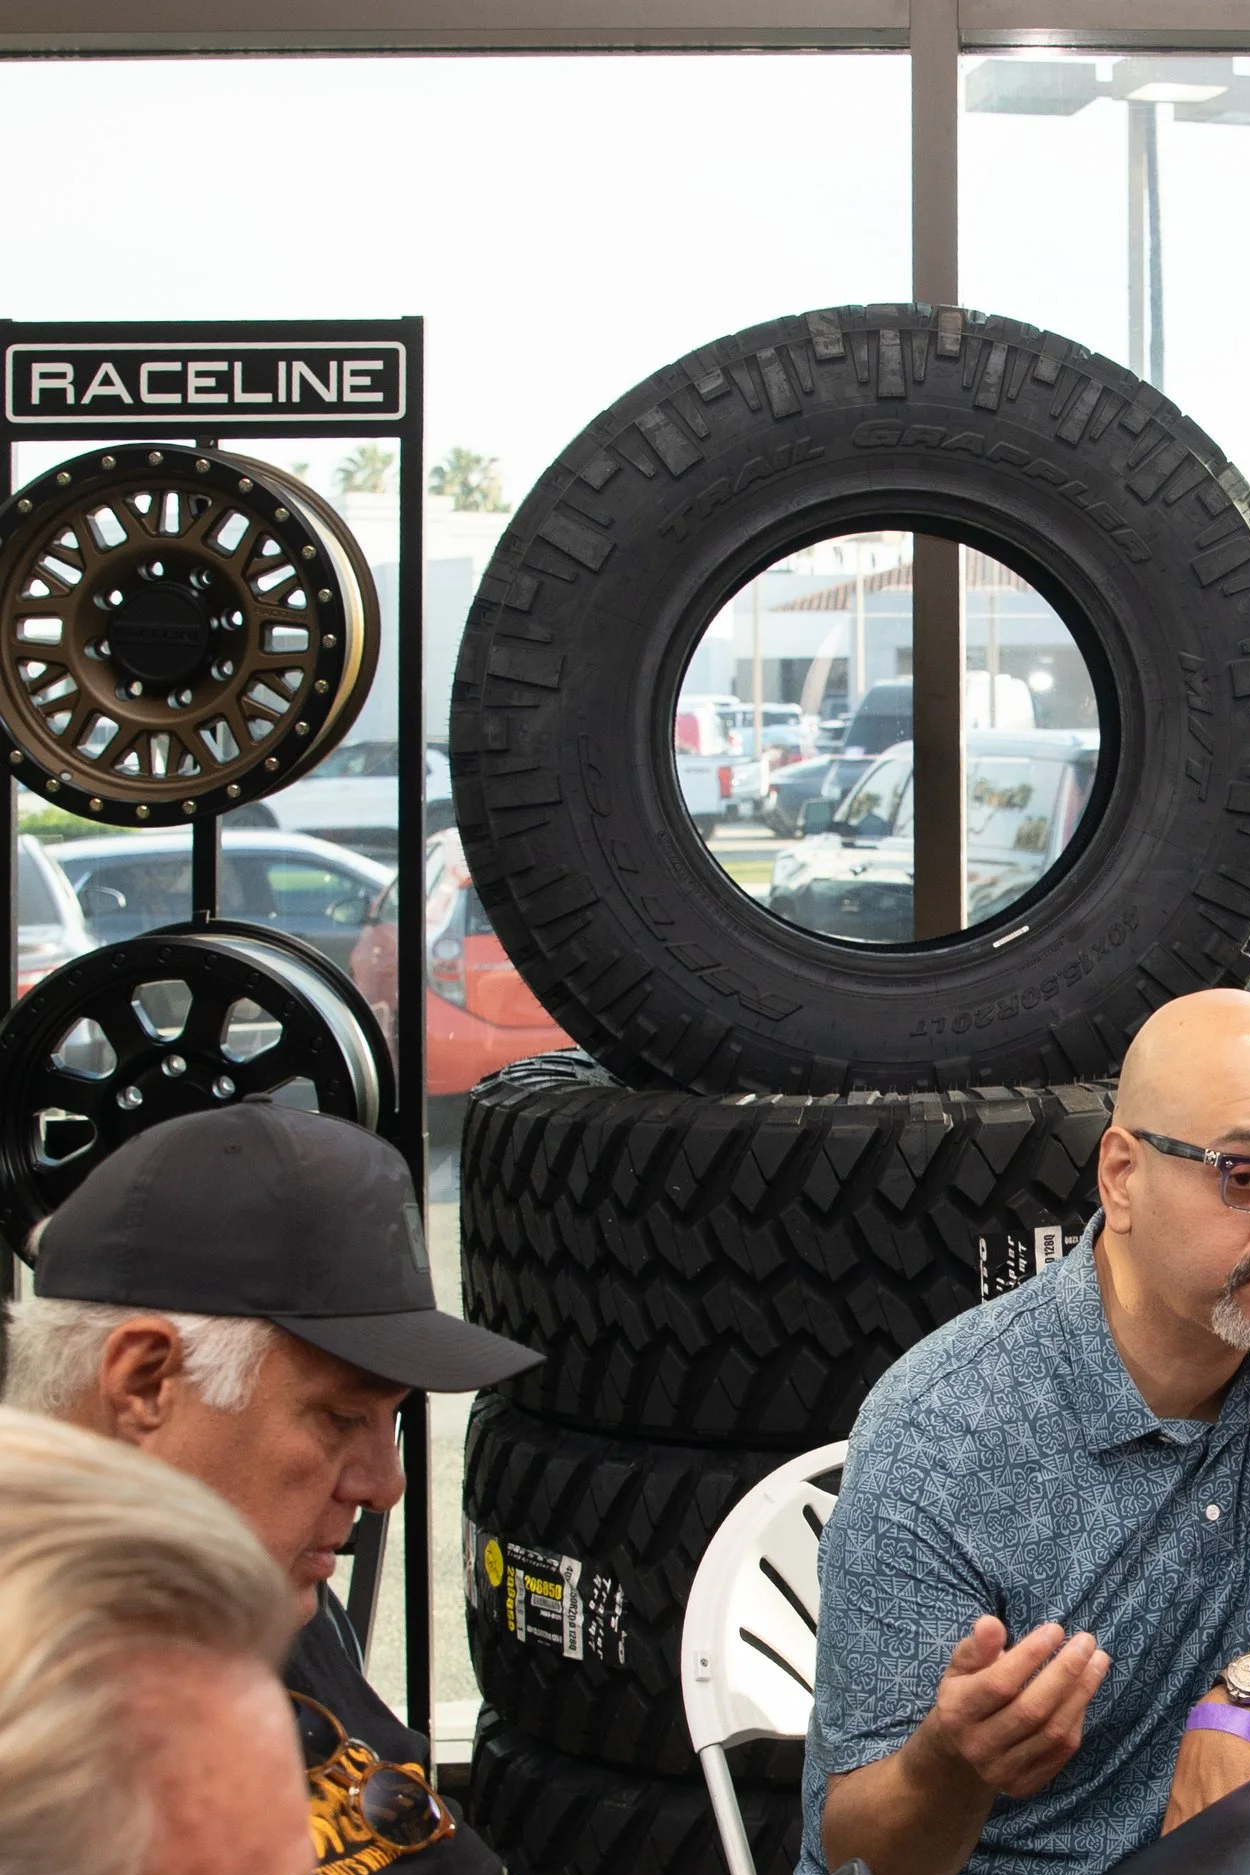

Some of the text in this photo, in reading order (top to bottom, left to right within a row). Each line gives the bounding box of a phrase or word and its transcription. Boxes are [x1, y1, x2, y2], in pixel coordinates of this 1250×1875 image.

[31, 360, 384, 405] RACELINE
[657, 418, 1153, 564] TRAIL GRAPPLER
[1177, 650, 1216, 803] M/T
[524, 1574, 563, 1601] 206850
